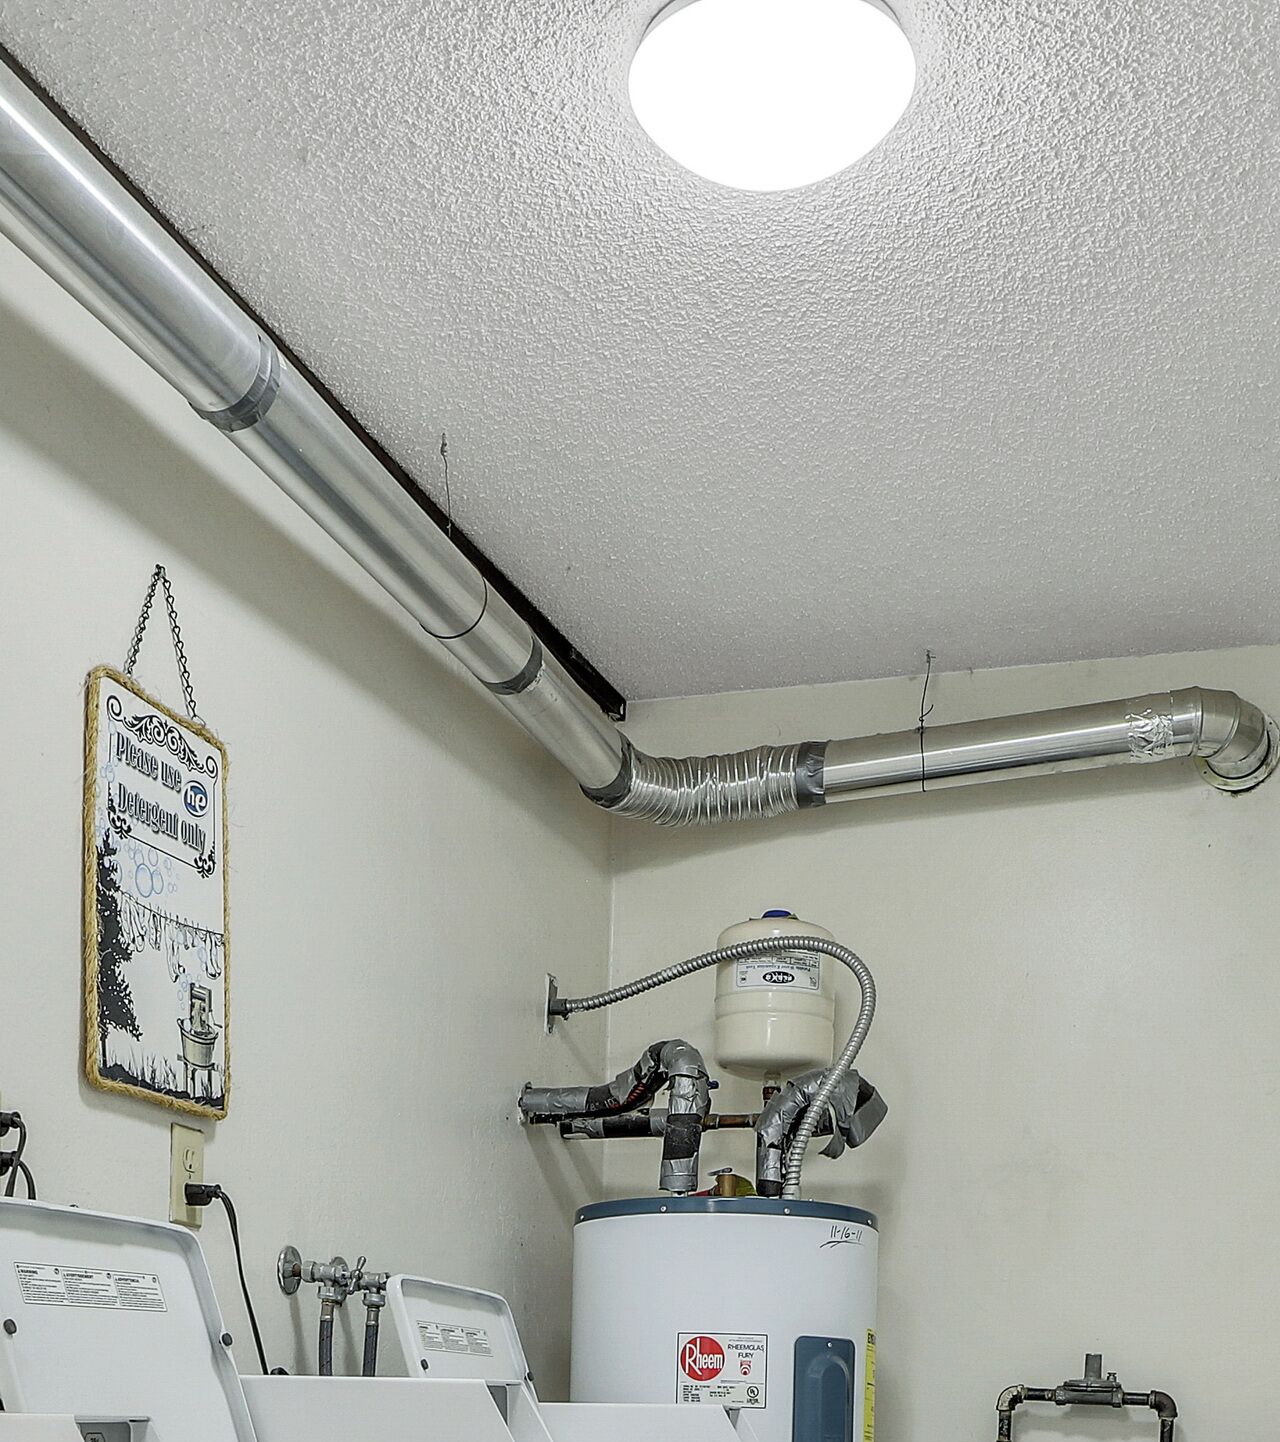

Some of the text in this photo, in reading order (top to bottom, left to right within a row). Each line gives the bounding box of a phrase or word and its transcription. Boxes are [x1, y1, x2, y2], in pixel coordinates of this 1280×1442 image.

[116, 732, 159, 781] Please
[161, 760, 182, 793] use
[118, 783, 207, 855] Detergent only
[830, 1225, 863, 1242] 11-16-11
[685, 1338, 723, 1376] Rheem
